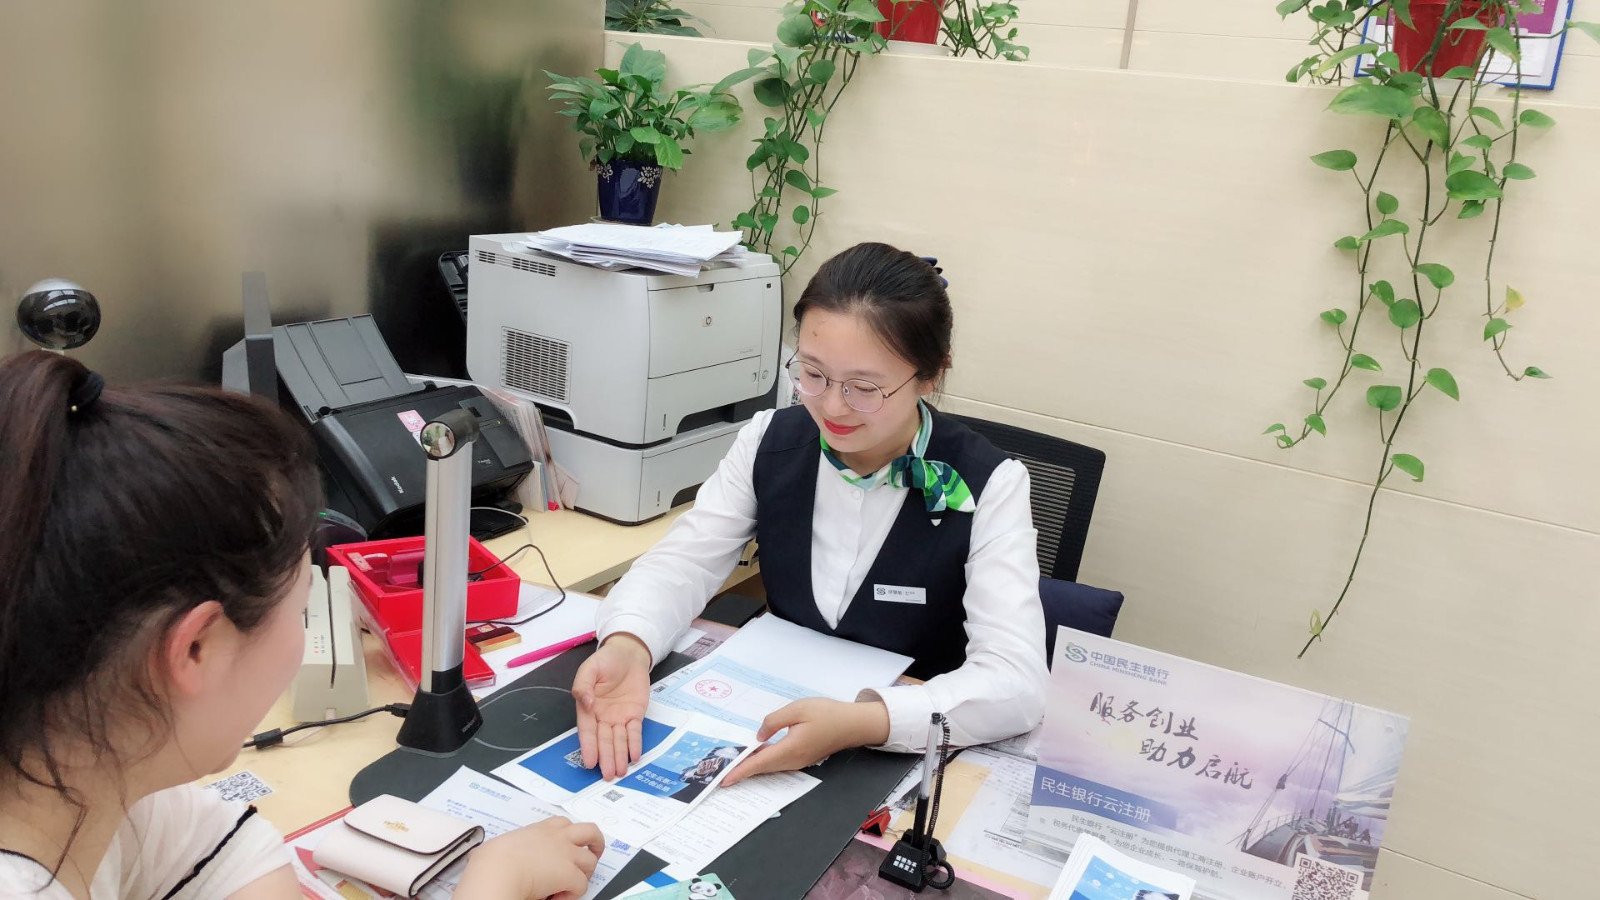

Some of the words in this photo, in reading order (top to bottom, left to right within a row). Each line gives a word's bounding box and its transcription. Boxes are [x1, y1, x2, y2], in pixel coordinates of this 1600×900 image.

[391, 476, 404, 493] Kodak
[1090, 650, 1170, 680] 中国民生银行
[1089, 691, 1199, 740] 服务创业
[1139, 738, 1253, 790] 助力启航
[1041, 776, 1152, 822] 民生银行云注册
